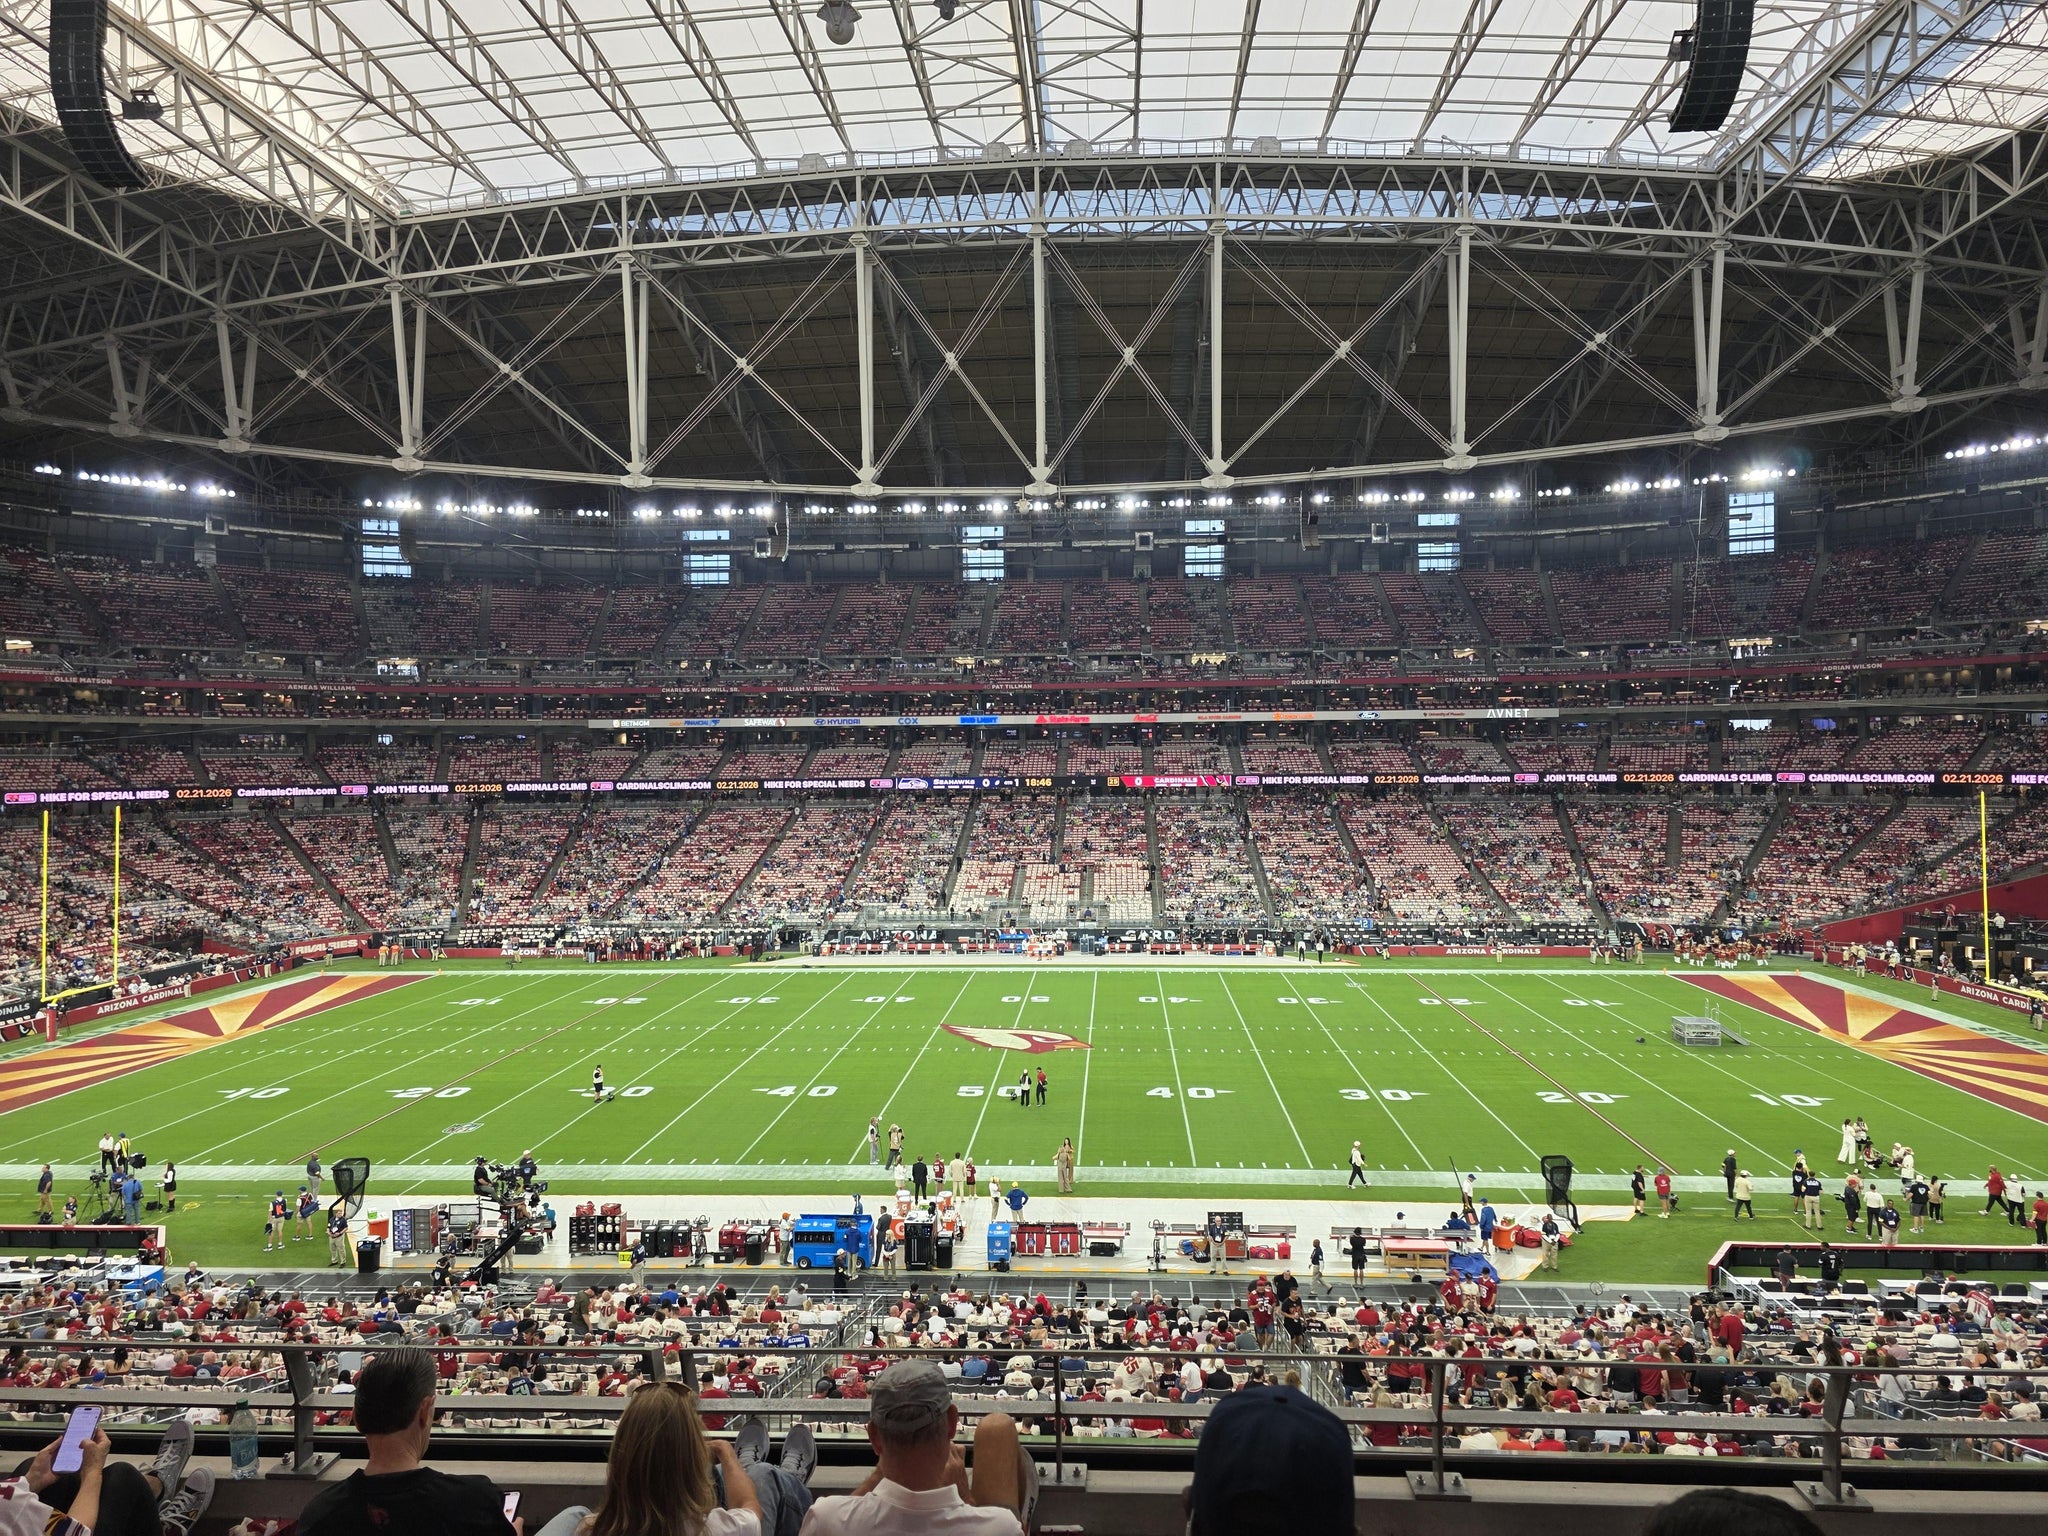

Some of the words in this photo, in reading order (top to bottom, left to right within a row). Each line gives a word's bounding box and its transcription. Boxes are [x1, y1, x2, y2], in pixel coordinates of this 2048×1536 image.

[1487, 709, 1529, 718] AVNET
[1135, 777, 1142, 785] 0
[1262, 776, 1283, 784] HIKE
[1284, 776, 1301, 784] FOR
[1302, 776, 1339, 784] SPECIAL
[1424, 775, 1510, 783] CardinalsClimb.com
[1544, 774, 1566, 782] JOIN
[1567, 774, 1586, 782] THE
[1587, 774, 1617, 782] CLIMB
[1624, 774, 1674, 782] 02.21.2026
[1679, 774, 1738, 782] CARDINALS
[1739, 774, 1772, 782] CLIMB
[1809, 774, 1935, 782] CARDINALSCLIMB.COM
[1943, 774, 2003, 783] 02.21.2026
[2012, 775, 2037, 783] HIKE
[507, 783, 559, 791] CARDINALS
[616, 782, 712, 790] CARDINALSCLIMB.COM
[983, 779, 990, 787] 0
[238, 787, 337, 796] CardinalsClimb.com
[373, 785, 397, 793] JOIN
[399, 785, 418, 793] THE
[419, 785, 449, 793] CLIMB
[455, 784, 502, 792] 02.21.2026
[40, 793, 67, 802] HIKE
[68, 792, 90, 801] FOR
[92, 792, 135, 801] SPECIAL
[136, 790, 170, 800] NEEDS
[177, 789, 232, 798] 02.21.2026
[1961, 985, 1999, 1001] ARIZONA
[97, 998, 139, 1014] ARIZONA
[142, 987, 184, 1003] CARDINAL
[224, 1088, 290, 1099] 10
[392, 1087, 471, 1098] 20
[767, 1086, 839, 1097] 40
[957, 1086, 1022, 1097] 50
[1146, 1087, 1215, 1098] 40
[1339, 1089, 1413, 1101] 30
[1536, 1092, 1615, 1104] 20
[1750, 1094, 1824, 1107] 10
[1830, 1260, 1835, 1268] 7
[96, 1315, 105, 1326] 31
[1124, 1356, 1139, 1375] 85
